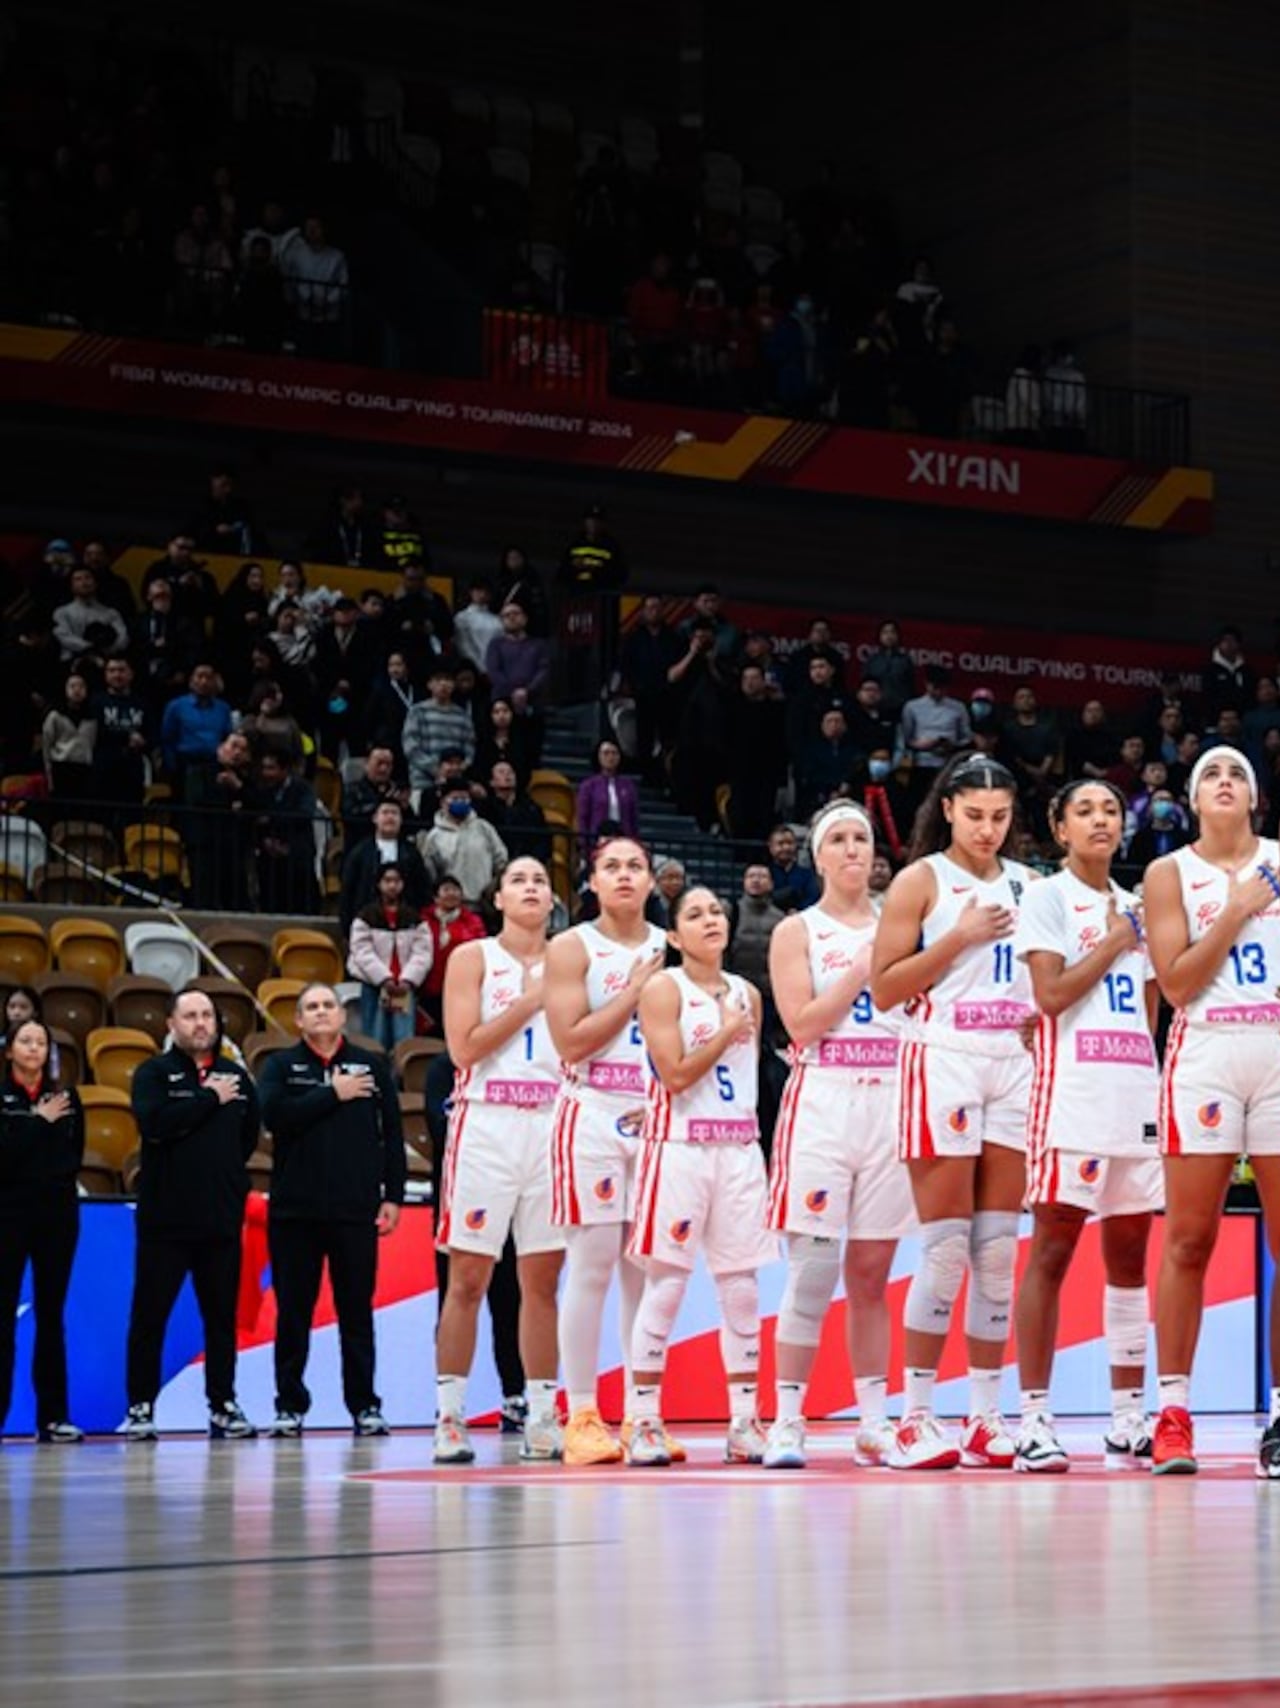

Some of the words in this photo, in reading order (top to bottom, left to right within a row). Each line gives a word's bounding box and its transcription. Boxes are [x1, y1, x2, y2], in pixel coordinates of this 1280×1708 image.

[109, 362, 155, 384] FIBA
[160, 367, 254, 396] WOMEN'S
[257, 379, 343, 406] OLYMPIC
[346, 390, 456, 420] QUALIFYING
[460, 403, 583, 433] TOURNAMENT
[587, 418, 634, 439] 2024
[906, 447, 1020, 495] XI'AN
[958, 651, 1087, 681] QUALIFYING
[993, 944, 1012, 983] 11
[1229, 942, 1267, 986] 13
[853, 990, 873, 1024] 9
[1104, 973, 1136, 1014] 12
[524, 1026, 533, 1061] 1
[716, 1065, 735, 1102] 5
